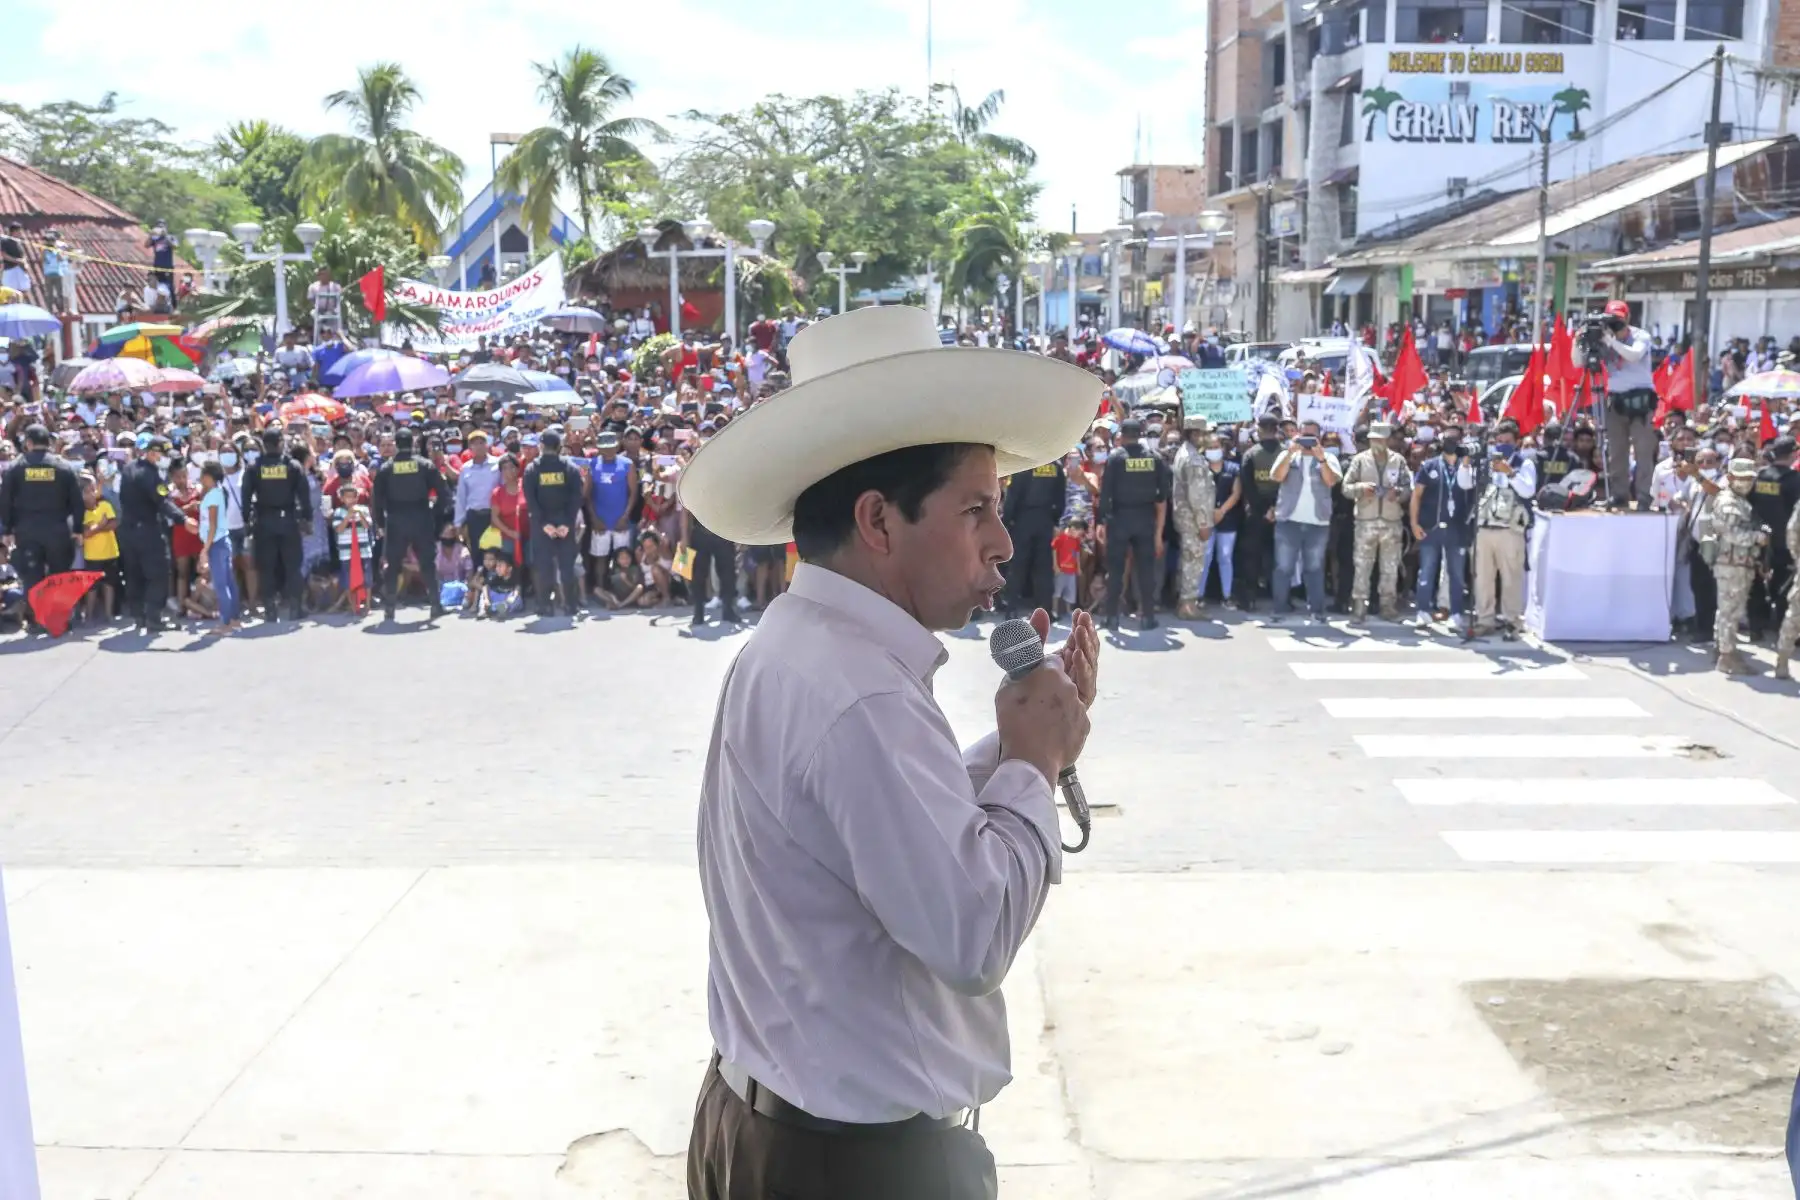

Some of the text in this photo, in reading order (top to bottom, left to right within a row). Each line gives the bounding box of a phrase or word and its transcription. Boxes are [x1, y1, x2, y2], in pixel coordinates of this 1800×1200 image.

[1389, 52, 1445, 73] WELCOME
[1449, 52, 1465, 73] TO
[1387, 101, 1558, 143] GRAN REY
